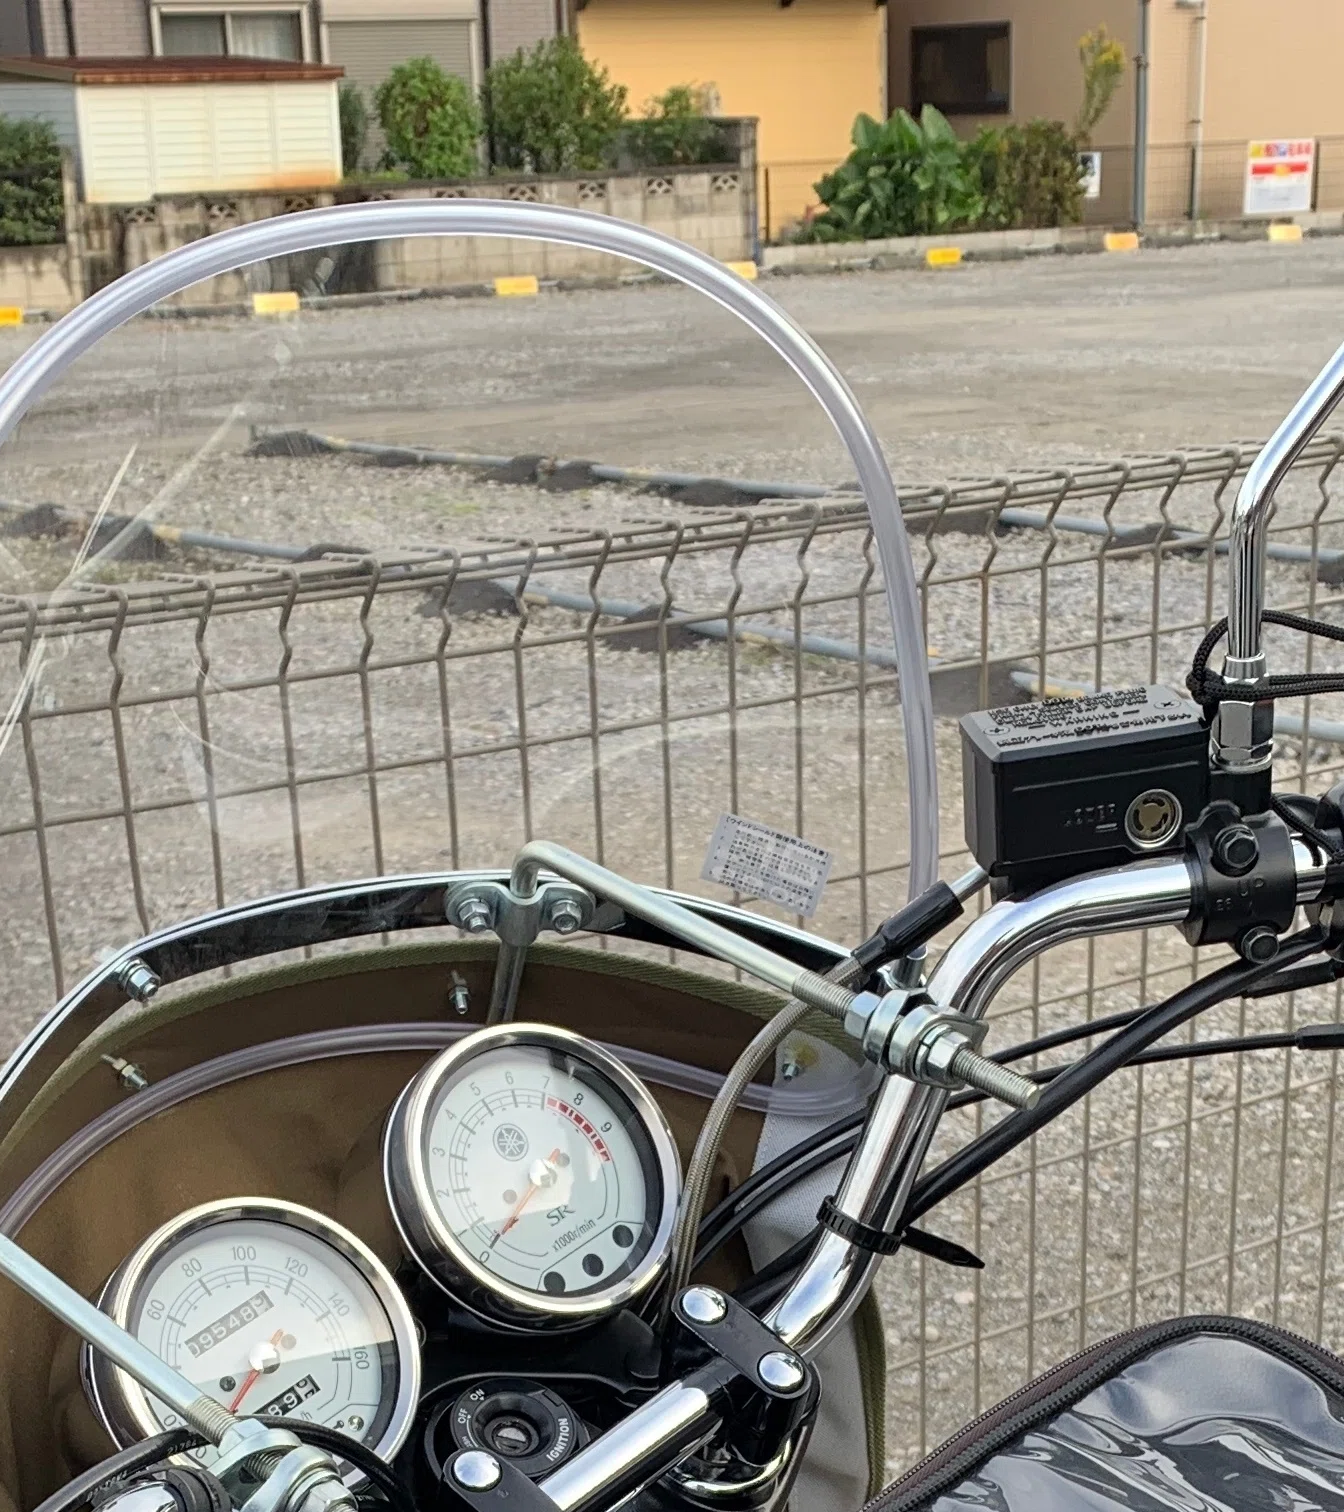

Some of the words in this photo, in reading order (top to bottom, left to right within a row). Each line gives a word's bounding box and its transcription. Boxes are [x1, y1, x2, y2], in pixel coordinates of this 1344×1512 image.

[505, 1071, 514, 1085] 6
[541, 1075, 550, 1089] 7
[469, 1082, 481, 1096] 5
[573, 1092, 584, 1106] 8
[444, 1109, 457, 1121] 4
[600, 1121, 613, 1133] 9
[432, 1147, 446, 1157] 3
[436, 1188, 450, 1199] 2
[231, 1245, 257, 1261] 100
[479, 1250, 490, 1263] 0
[181, 1257, 202, 1278] 80
[284, 1256, 309, 1278] 120
[146, 1299, 166, 1321] 60
[327, 1292, 350, 1317] 140
[353, 1344, 370, 1370] 160
[470, 1388, 485, 1401] ON
[457, 1408, 468, 1424] OFF
[546, 1418, 570, 1461] IGNITION
